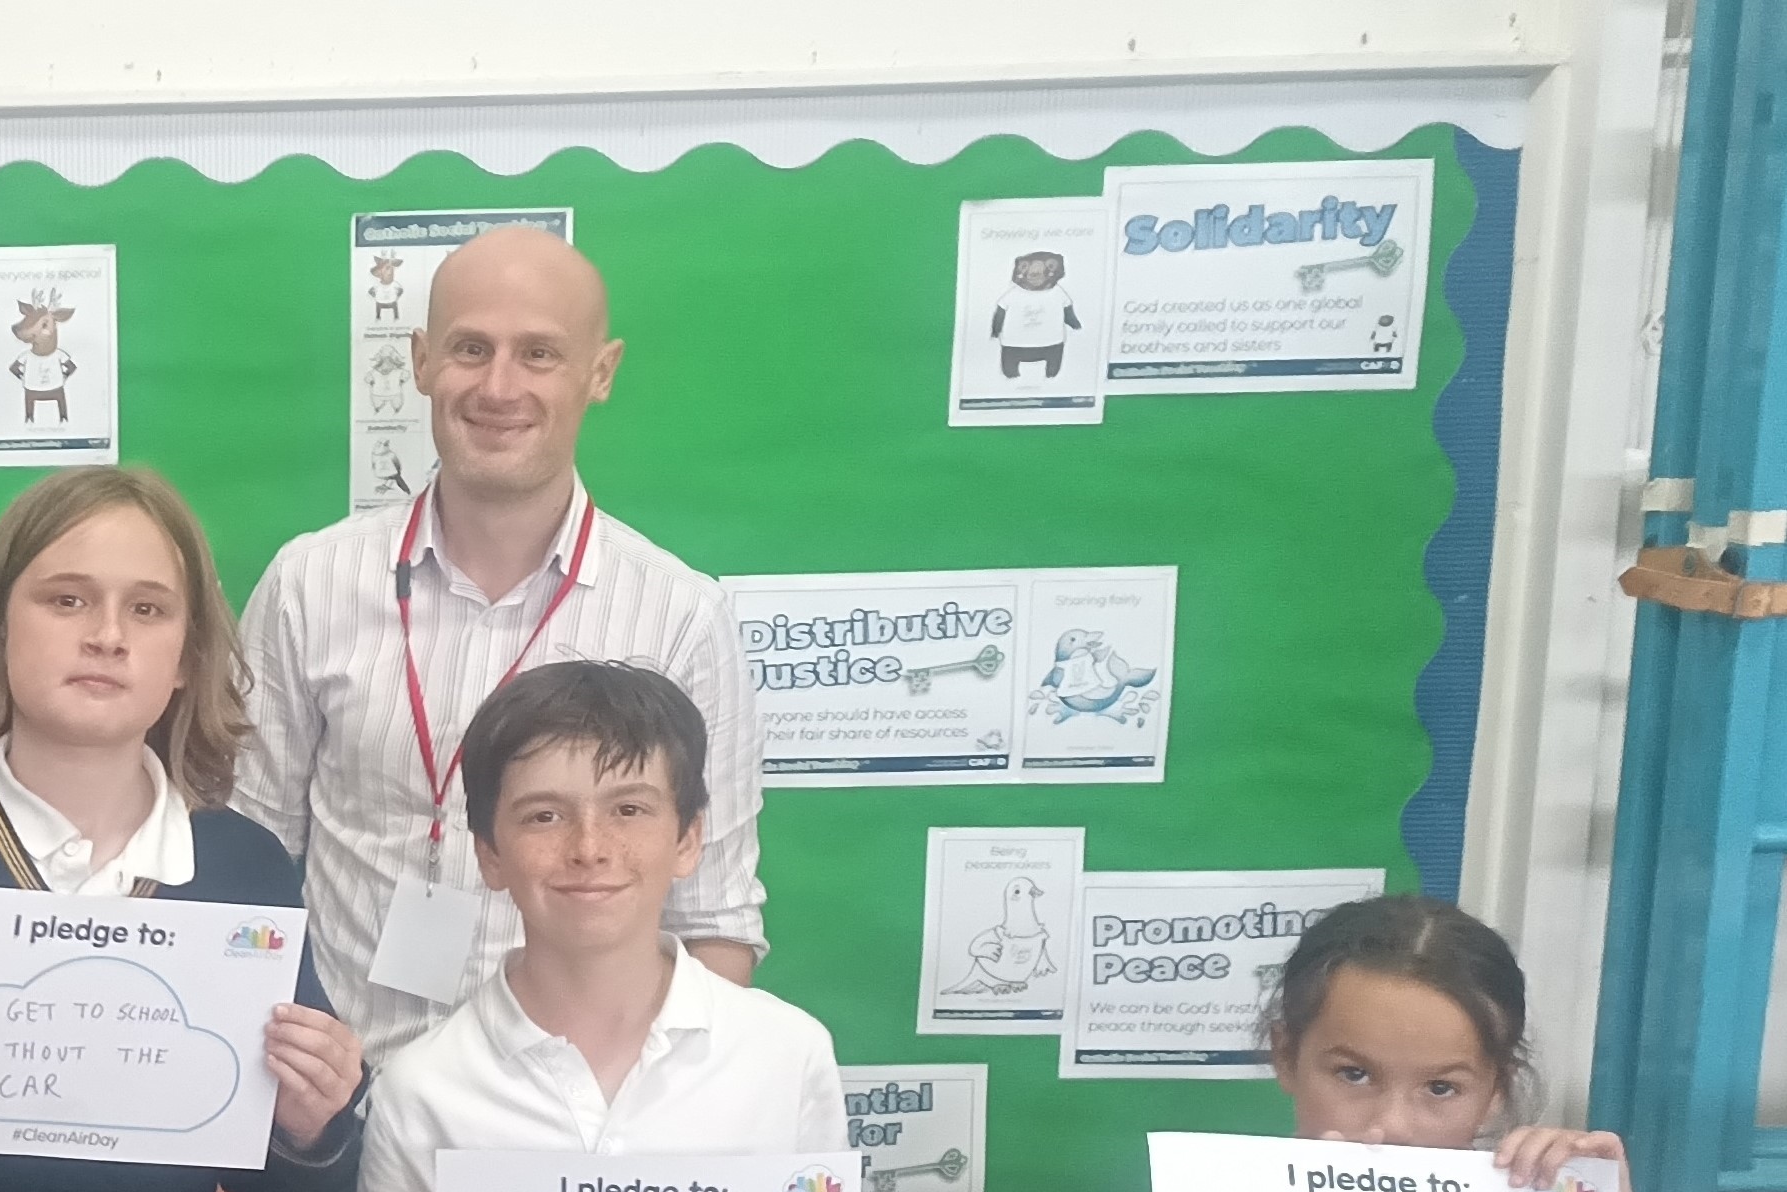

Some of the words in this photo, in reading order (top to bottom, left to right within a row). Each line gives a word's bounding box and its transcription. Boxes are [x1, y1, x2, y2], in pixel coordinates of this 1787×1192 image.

[1124, 195, 1398, 257] Solidarity
[58, 268, 102, 281] special
[1124, 300, 1158, 314] God
[1162, 298, 1225, 314] created
[1230, 300, 1249, 313] us
[1252, 300, 1270, 312] as
[1274, 300, 1307, 311] one
[1311, 295, 1364, 313] global
[1122, 320, 1174, 337] family
[1177, 318, 1228, 334] called
[1231, 319, 1248, 332] to
[1250, 318, 1316, 337] support
[1318, 318, 1346, 331] our
[1120, 341, 1190, 354] brothers
[1193, 339, 1228, 353] and
[1231, 339, 1282, 352] sisters
[740, 601, 1013, 652] Distributive
[747, 649, 902, 692] Justice
[763, 712, 813, 724] eryone
[816, 709, 870, 722] should
[873, 709, 911, 720] have
[915, 709, 968, 720] access
[766, 729, 795, 741] heir
[800, 728, 824, 740] fair
[829, 728, 871, 740] share
[876, 727, 891, 739] of
[894, 727, 968, 738] resources
[13, 915, 21, 937] I
[30, 914, 128, 948] pledge
[138, 922, 176, 947] to:
[1093, 950, 1231, 985] Peace
[6, 998, 56, 1022] GET
[74, 1002, 104, 1020] TO
[116, 1005, 180, 1023] SCHOOL
[1090, 1002, 1116, 1014] We
[1119, 1004, 1150, 1014] can
[1153, 1003, 1173, 1014] be
[1176, 1002, 1220, 1014] God's
[1088, 1022, 1136, 1034] peace
[1140, 1021, 1205, 1035] through
[1208, 1021, 1260, 1033] seekin
[117, 1047, 169, 1065] THE
[12, 1127, 119, 1150] #CleanAirDay
[847, 1118, 902, 1148] for
[1286, 1163, 1296, 1187] I
